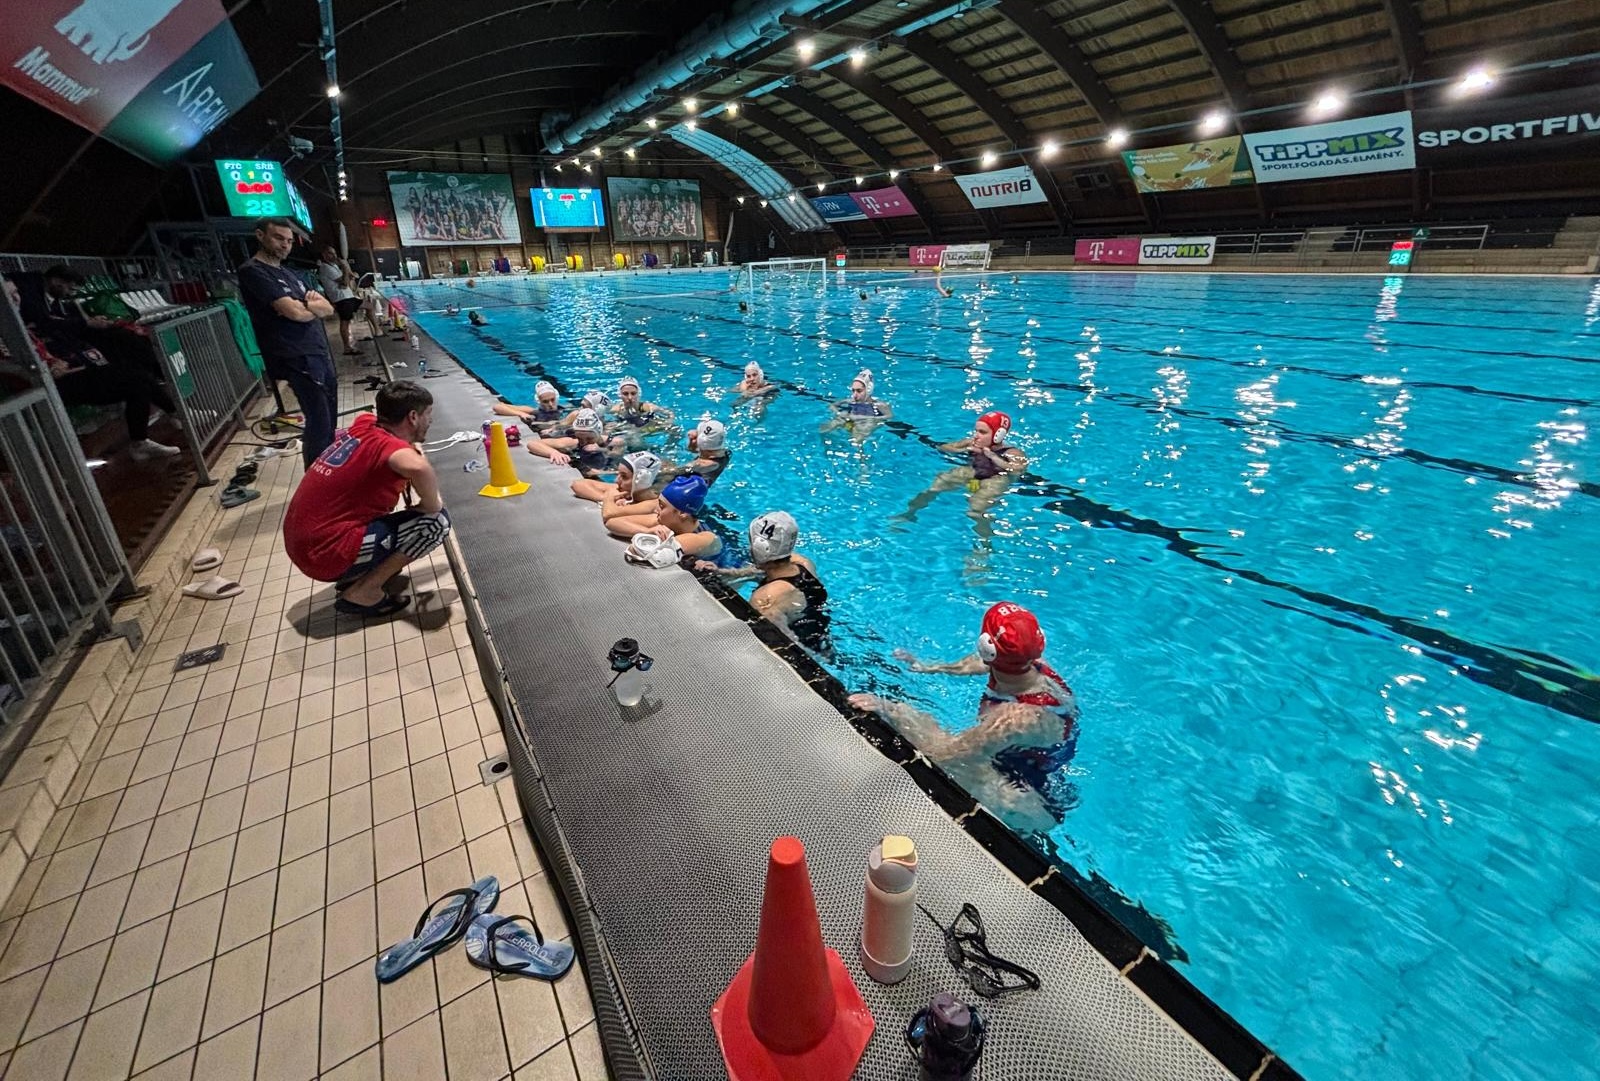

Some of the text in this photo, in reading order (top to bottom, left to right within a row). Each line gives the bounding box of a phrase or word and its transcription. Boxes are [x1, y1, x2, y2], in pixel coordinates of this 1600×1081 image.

[13, 46, 96, 104] Mammut
[230, 171, 273, 181] 0 1 0
[246, 200, 277, 215] 28
[1388, 253, 1409, 265] 28
[599, 396, 609, 406] 15
[1000, 415, 1010, 428] 13
[703, 426, 712, 435] 9
[646, 457, 656, 468] 7
[760, 520, 775, 539] 14
